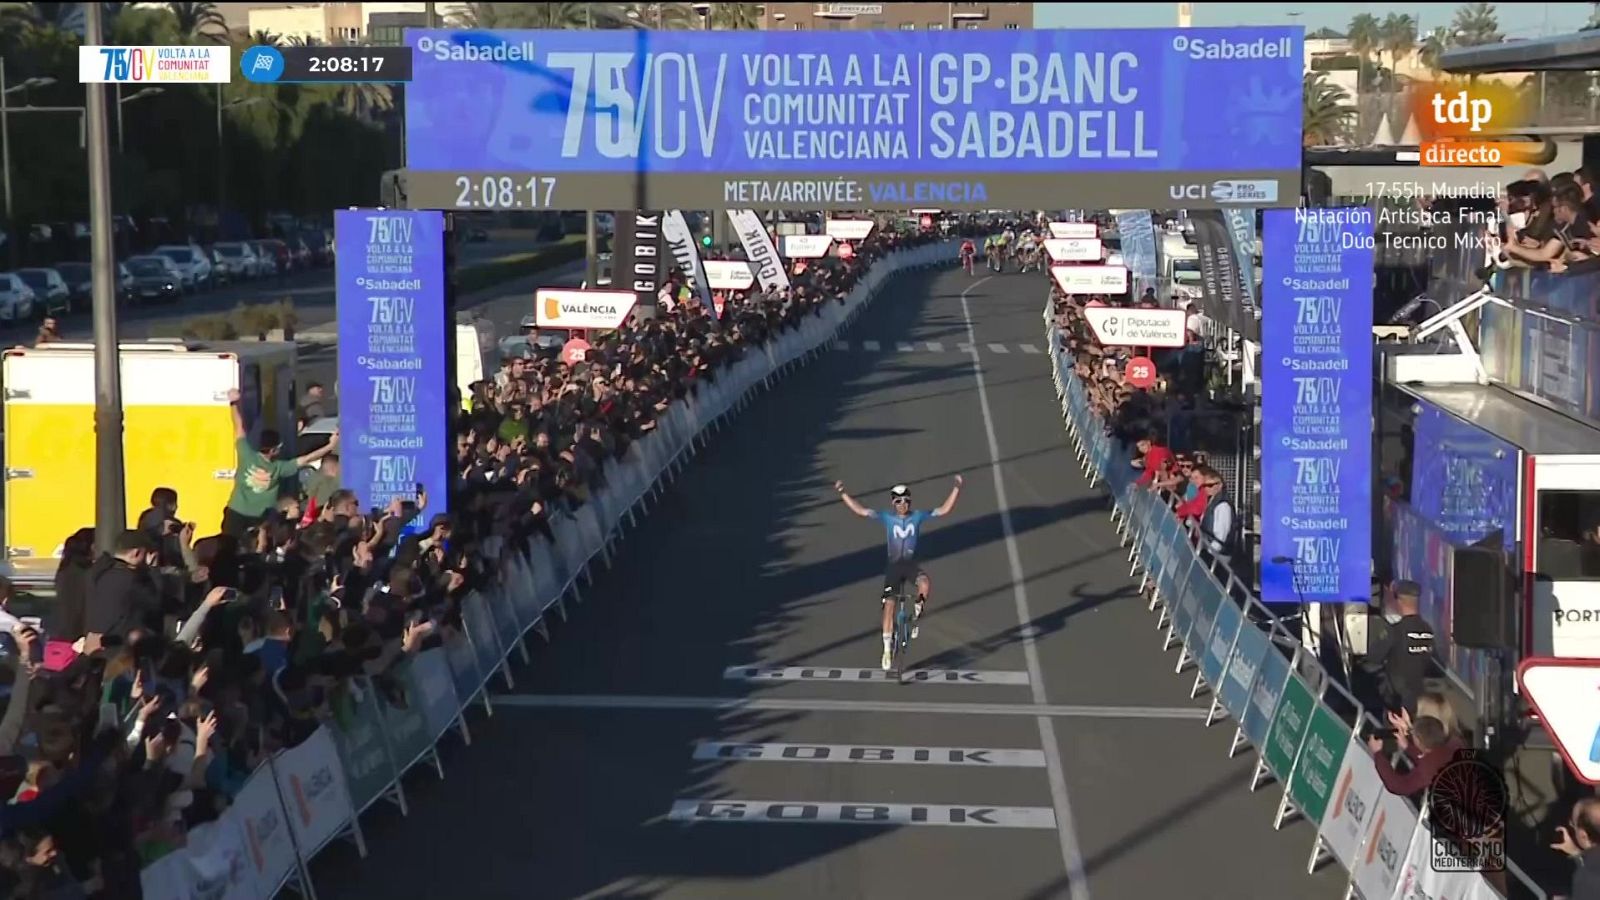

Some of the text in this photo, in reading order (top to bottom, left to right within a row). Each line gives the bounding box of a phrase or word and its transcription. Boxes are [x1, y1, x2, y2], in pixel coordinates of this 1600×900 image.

[434, 39, 534, 61] Sabadell
[1190, 37, 1291, 59] Sabadell
[742, 54, 911, 86] VOLTA A LA
[744, 93, 910, 125] COMUNITAT
[930, 110, 1158, 159] SABADELL
[744, 130, 909, 160] VALENCIANA
[455, 176, 556, 207] 2:08:17
[869, 182, 988, 203] VALENCIA
[1170, 184, 1206, 199] UCI
[634, 214, 658, 292] GOBIK
[365, 279, 421, 290] Sabadell
[1292, 278, 1349, 290] Sabadell
[569, 348, 586, 360] 25
[366, 358, 422, 369] Sabadell
[1132, 366, 1149, 378] 25
[1291, 359, 1348, 370] Sabadell
[368, 437, 423, 448] Sabadell
[1291, 438, 1348, 450] Sabadell
[1291, 518, 1347, 529] Sabadell
[717, 745, 991, 763] GOBIK
[696, 802, 998, 824] GOBIK
